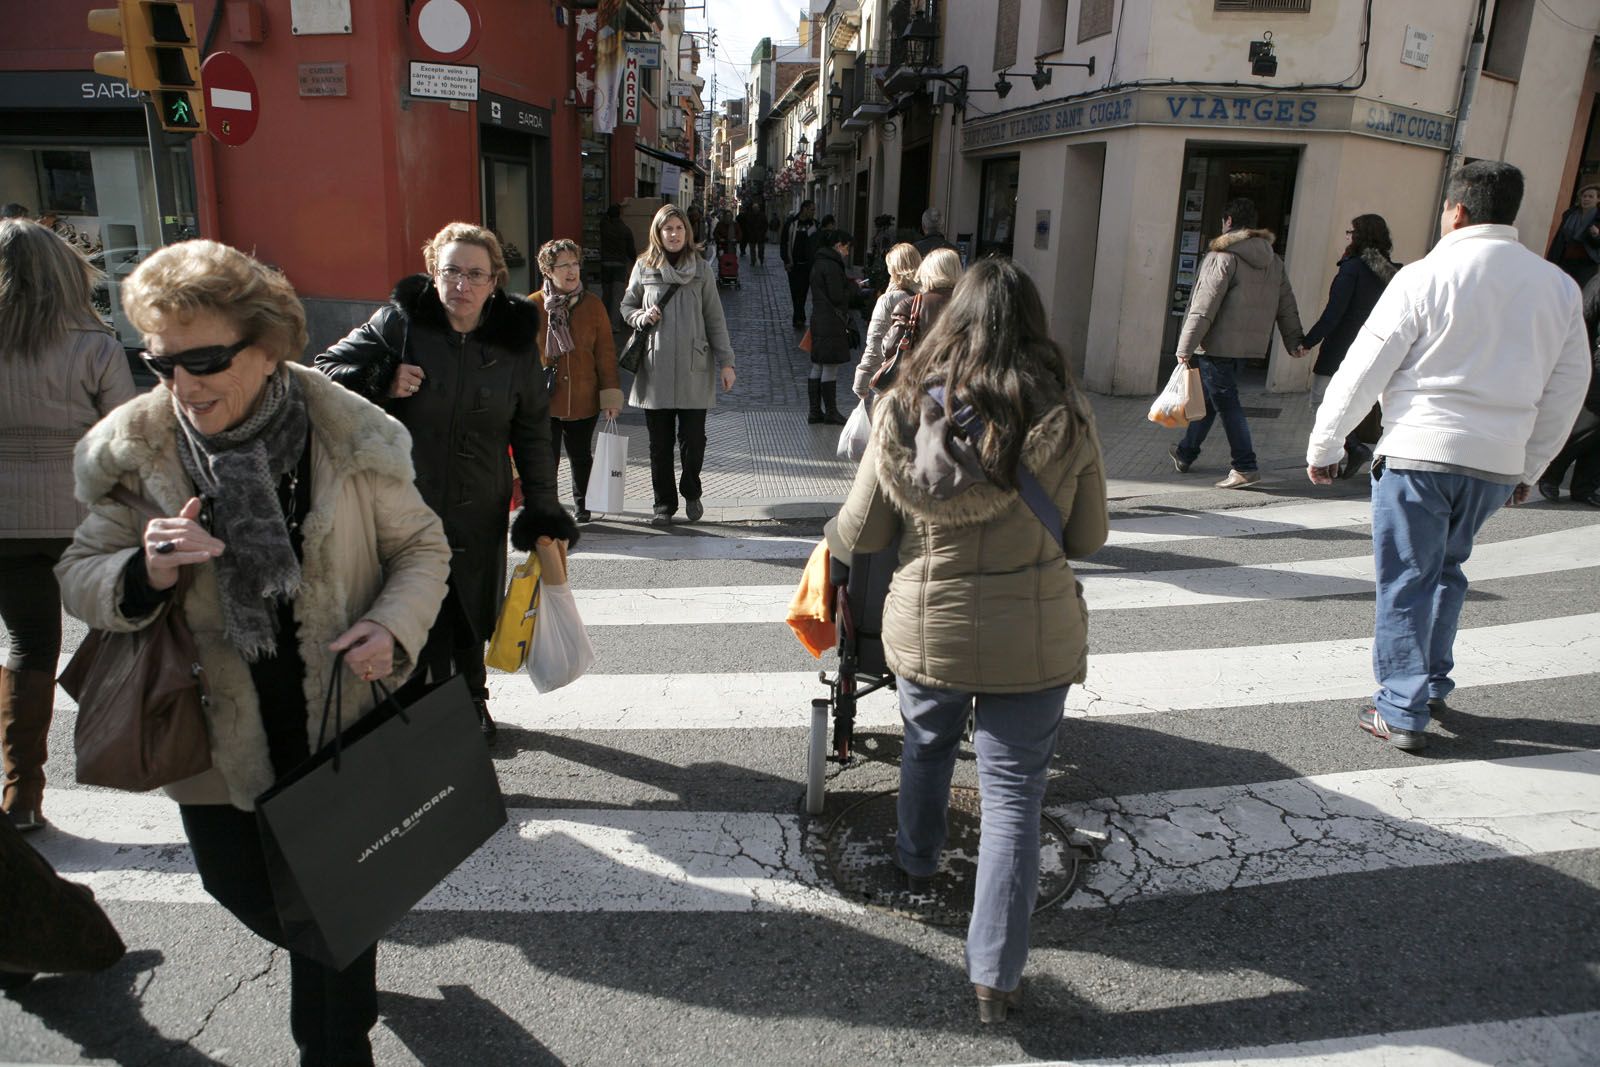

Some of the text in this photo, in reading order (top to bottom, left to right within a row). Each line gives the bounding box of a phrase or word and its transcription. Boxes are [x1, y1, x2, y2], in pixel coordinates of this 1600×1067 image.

[421, 65, 445, 73] Excepte
[626, 58, 637, 120] MARGA
[1010, 113, 1050, 137] VIATGES
[1055, 108, 1084, 129] SANT
[1089, 98, 1132, 124] CUGAT
[1166, 96, 1317, 123] VIATGES
[1366, 107, 1453, 143] SANT CUGAT
[357, 785, 455, 863] JAVIER SIMORRA
